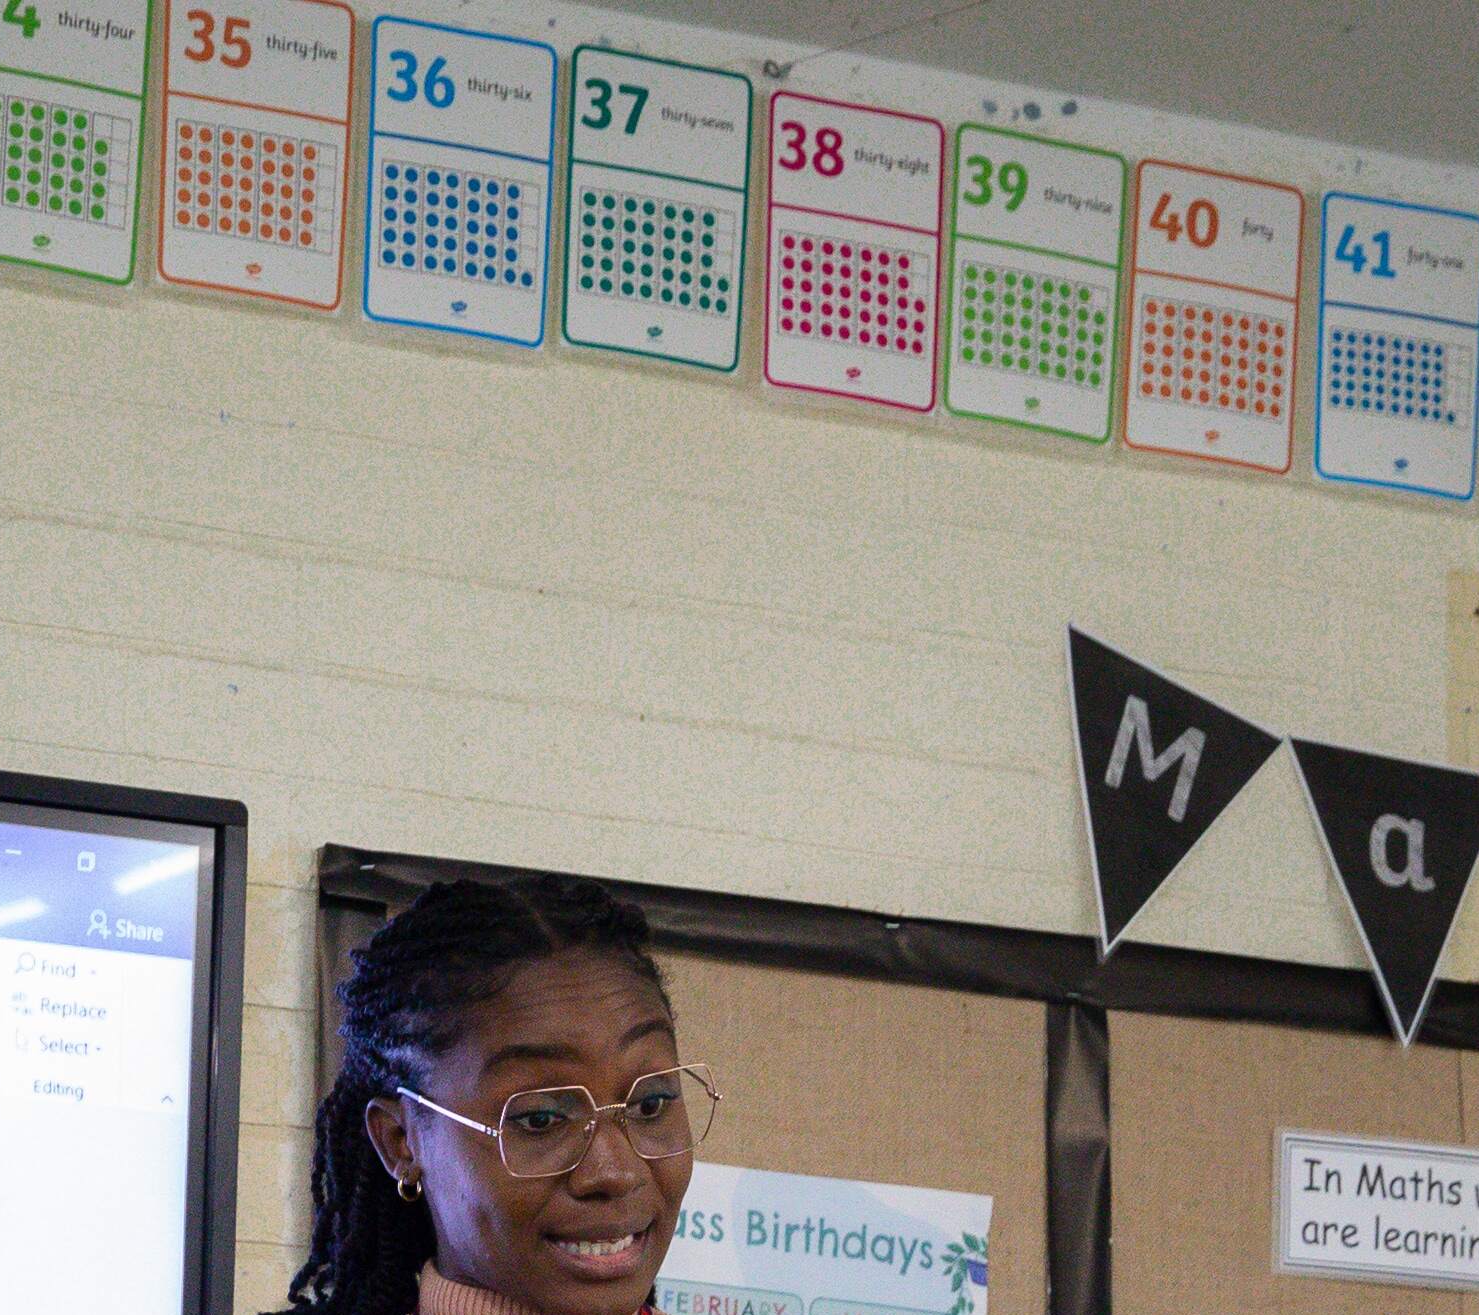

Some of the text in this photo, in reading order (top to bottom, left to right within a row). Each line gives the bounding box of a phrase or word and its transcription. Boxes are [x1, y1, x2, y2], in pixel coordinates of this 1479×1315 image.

[58, 10, 136, 40] thirty-four
[184, 9, 338, 69] 35 thirty-five
[386, 49, 532, 109] 36 thirty-six
[581, 77, 650, 135] 37
[778, 120, 845, 178] 38
[963, 154, 1029, 212] 39
[1149, 192, 1220, 249] 40
[1334, 224, 1396, 279] 41
[116, 918, 164, 944] Share
[40, 997, 107, 1019] Replace
[33, 1080, 85, 1102] Editing
[1303, 1158, 1342, 1195] In
[1356, 1163, 1462, 1206] Maths
[746, 1209, 934, 1276] Birthdays
[1301, 1220, 1360, 1249] are
